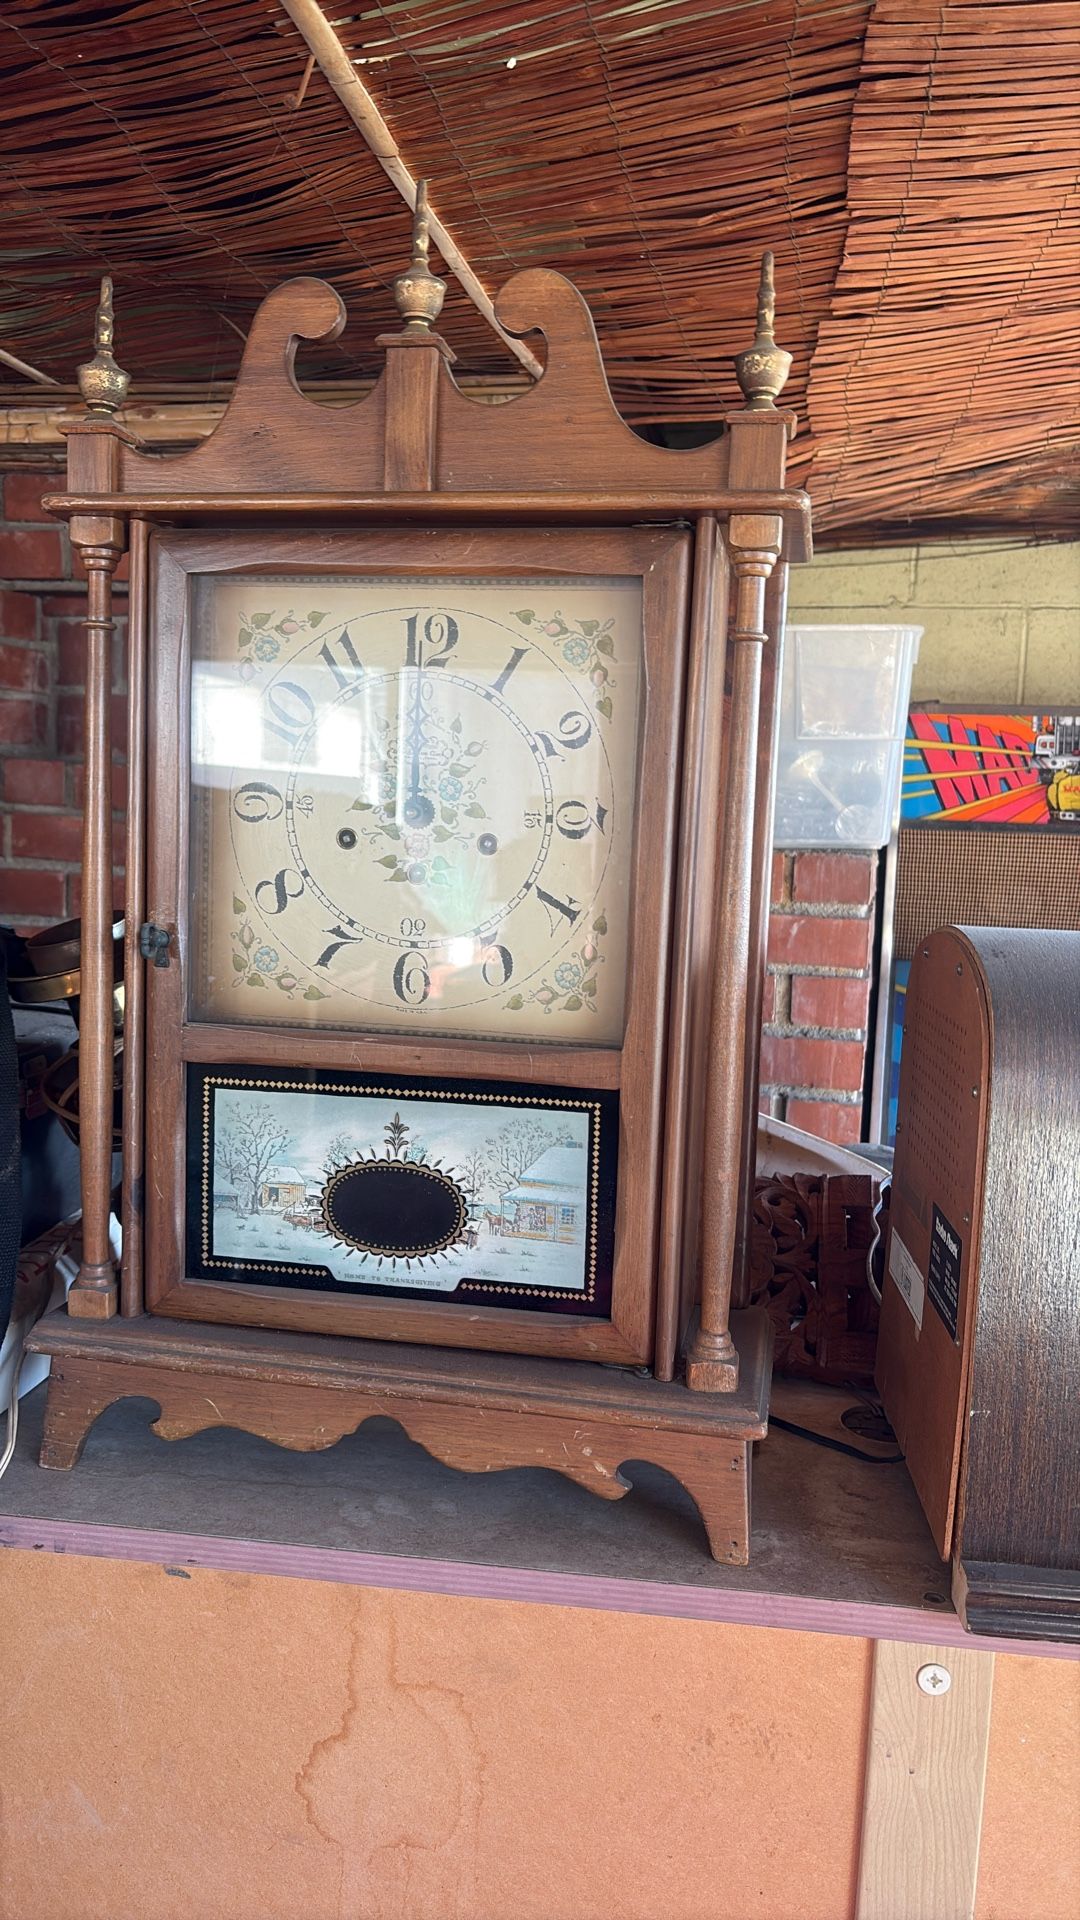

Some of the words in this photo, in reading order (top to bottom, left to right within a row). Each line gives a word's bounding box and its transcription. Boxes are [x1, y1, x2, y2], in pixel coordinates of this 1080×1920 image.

[400, 612, 459, 669] 12
[490, 646, 532, 697] 1
[264, 682, 316, 746] 10
[533, 711, 592, 762] 2
[233, 782, 284, 823] 9
[295, 794, 314, 819] 45
[524, 809, 544, 829] 15
[556, 797, 608, 840] 3
[255, 868, 305, 915] 8
[536, 885, 582, 937] 4
[314, 924, 363, 968] 7
[400, 917, 426, 937] 30
[393, 951, 431, 1005] 6
[479, 932, 514, 987] 5
